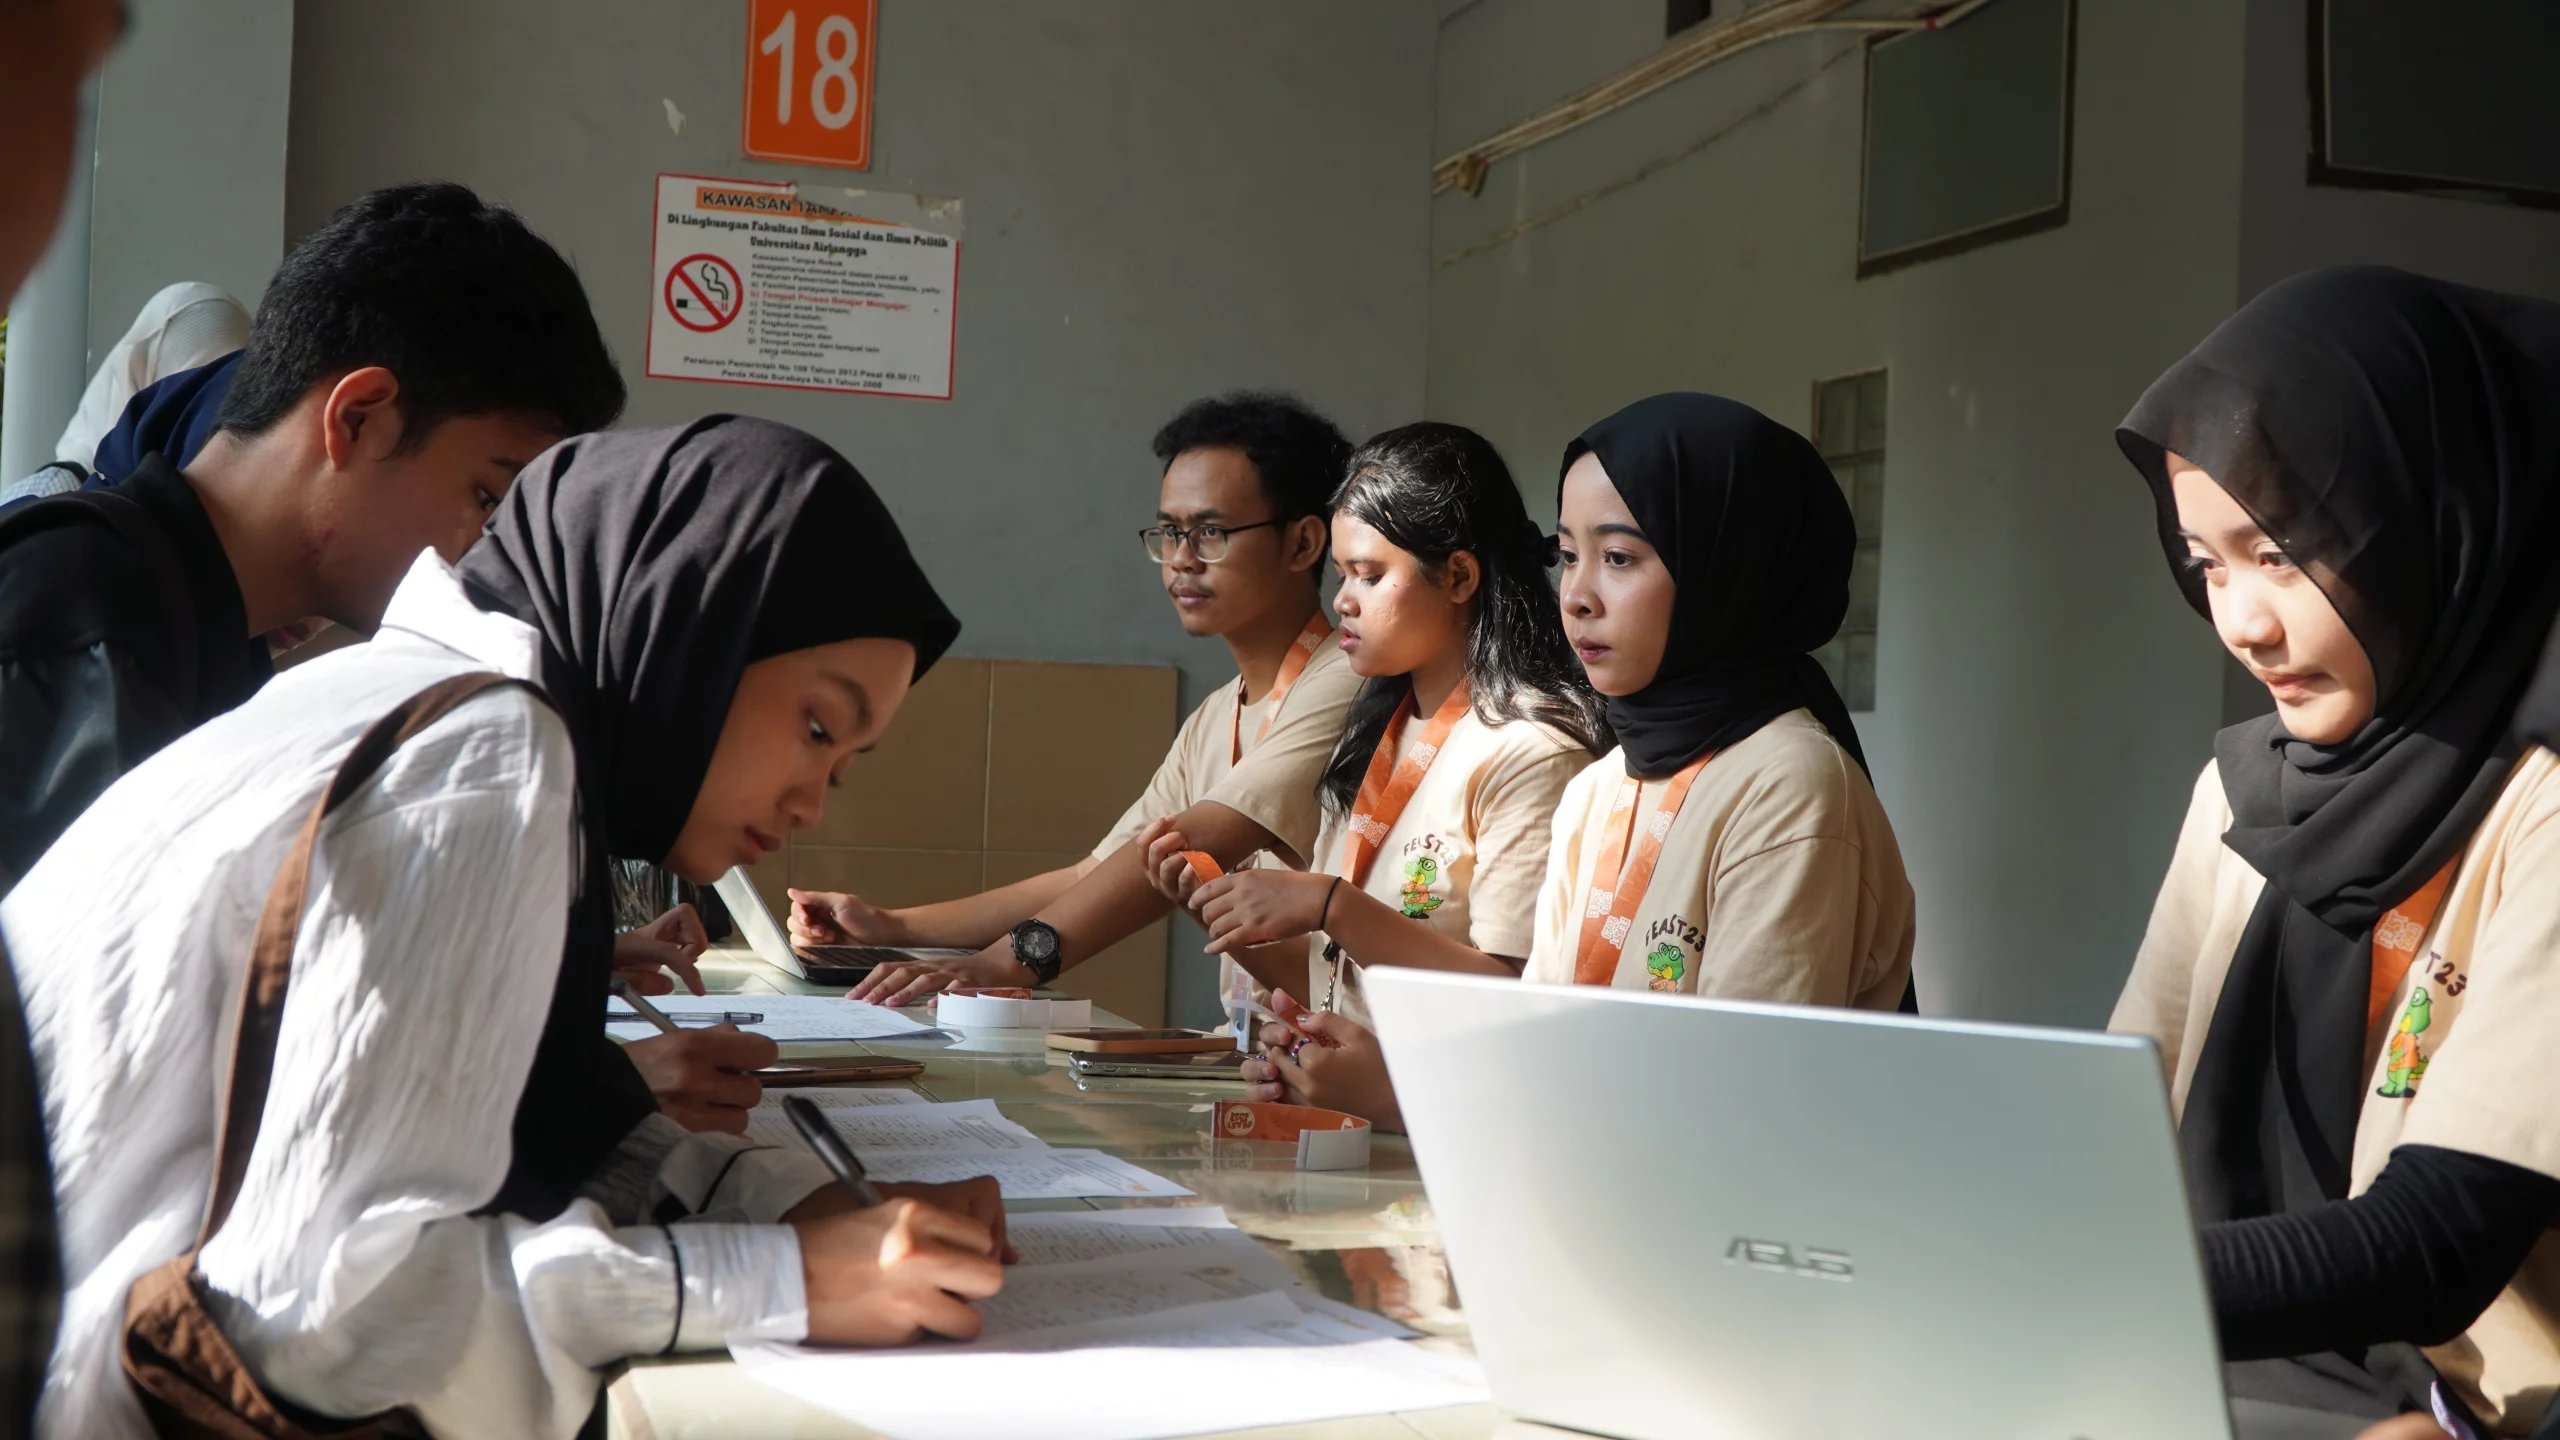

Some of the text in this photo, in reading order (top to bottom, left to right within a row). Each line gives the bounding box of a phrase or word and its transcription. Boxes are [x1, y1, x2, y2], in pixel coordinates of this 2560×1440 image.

[761, 9, 858, 130] 18
[703, 191, 792, 212] KAWASAN
[667, 213, 949, 248] Di Lingkungan Fakultas Ilmu Sosial dan Ilmu Politik
[750, 236, 867, 257] Universitas Airlangga
[752, 253, 843, 267] Kawasan Tanpa Rokok
[751, 271, 792, 281] Peraturan
[793, 275, 840, 285] Pemerintah
[841, 279, 877, 289] Republik
[807, 267, 847, 277] dimaksud
[849, 271, 873, 280] dalam
[762, 282, 797, 292] Fasilitas
[798, 285, 840, 296] pelayanan
[762, 292, 796, 302] Tempat
[798, 294, 830, 304] Proses
[831, 296, 864, 307] Belajar
[762, 301, 792, 310] Tempat
[794, 304, 813, 312] anak
[761, 310, 792, 319] Tempat
[760, 319, 800, 329] Angkutan
[760, 328, 791, 338] Tempat
[816, 333, 833, 341] dan
[759, 348, 779, 357] yang
[760, 337, 791, 347] Tempat
[791, 341, 817, 350] umum
[818, 342, 834, 350] dan
[835, 343, 863, 353] tempat
[684, 355, 726, 366] Peraturan
[728, 359, 777, 370] Pemerintah
[778, 363, 790, 371] No
[810, 365, 836, 374] Tahun
[859, 370, 883, 378] Pasal
[722, 369, 747, 379] Perda
[749, 371, 768, 380] Kota
[770, 373, 811, 384] Surabaya
[835, 378, 860, 387] Tahun
[1645, 913, 1706, 952] FEAST23
[1724, 1235, 1855, 1281] ASUS
